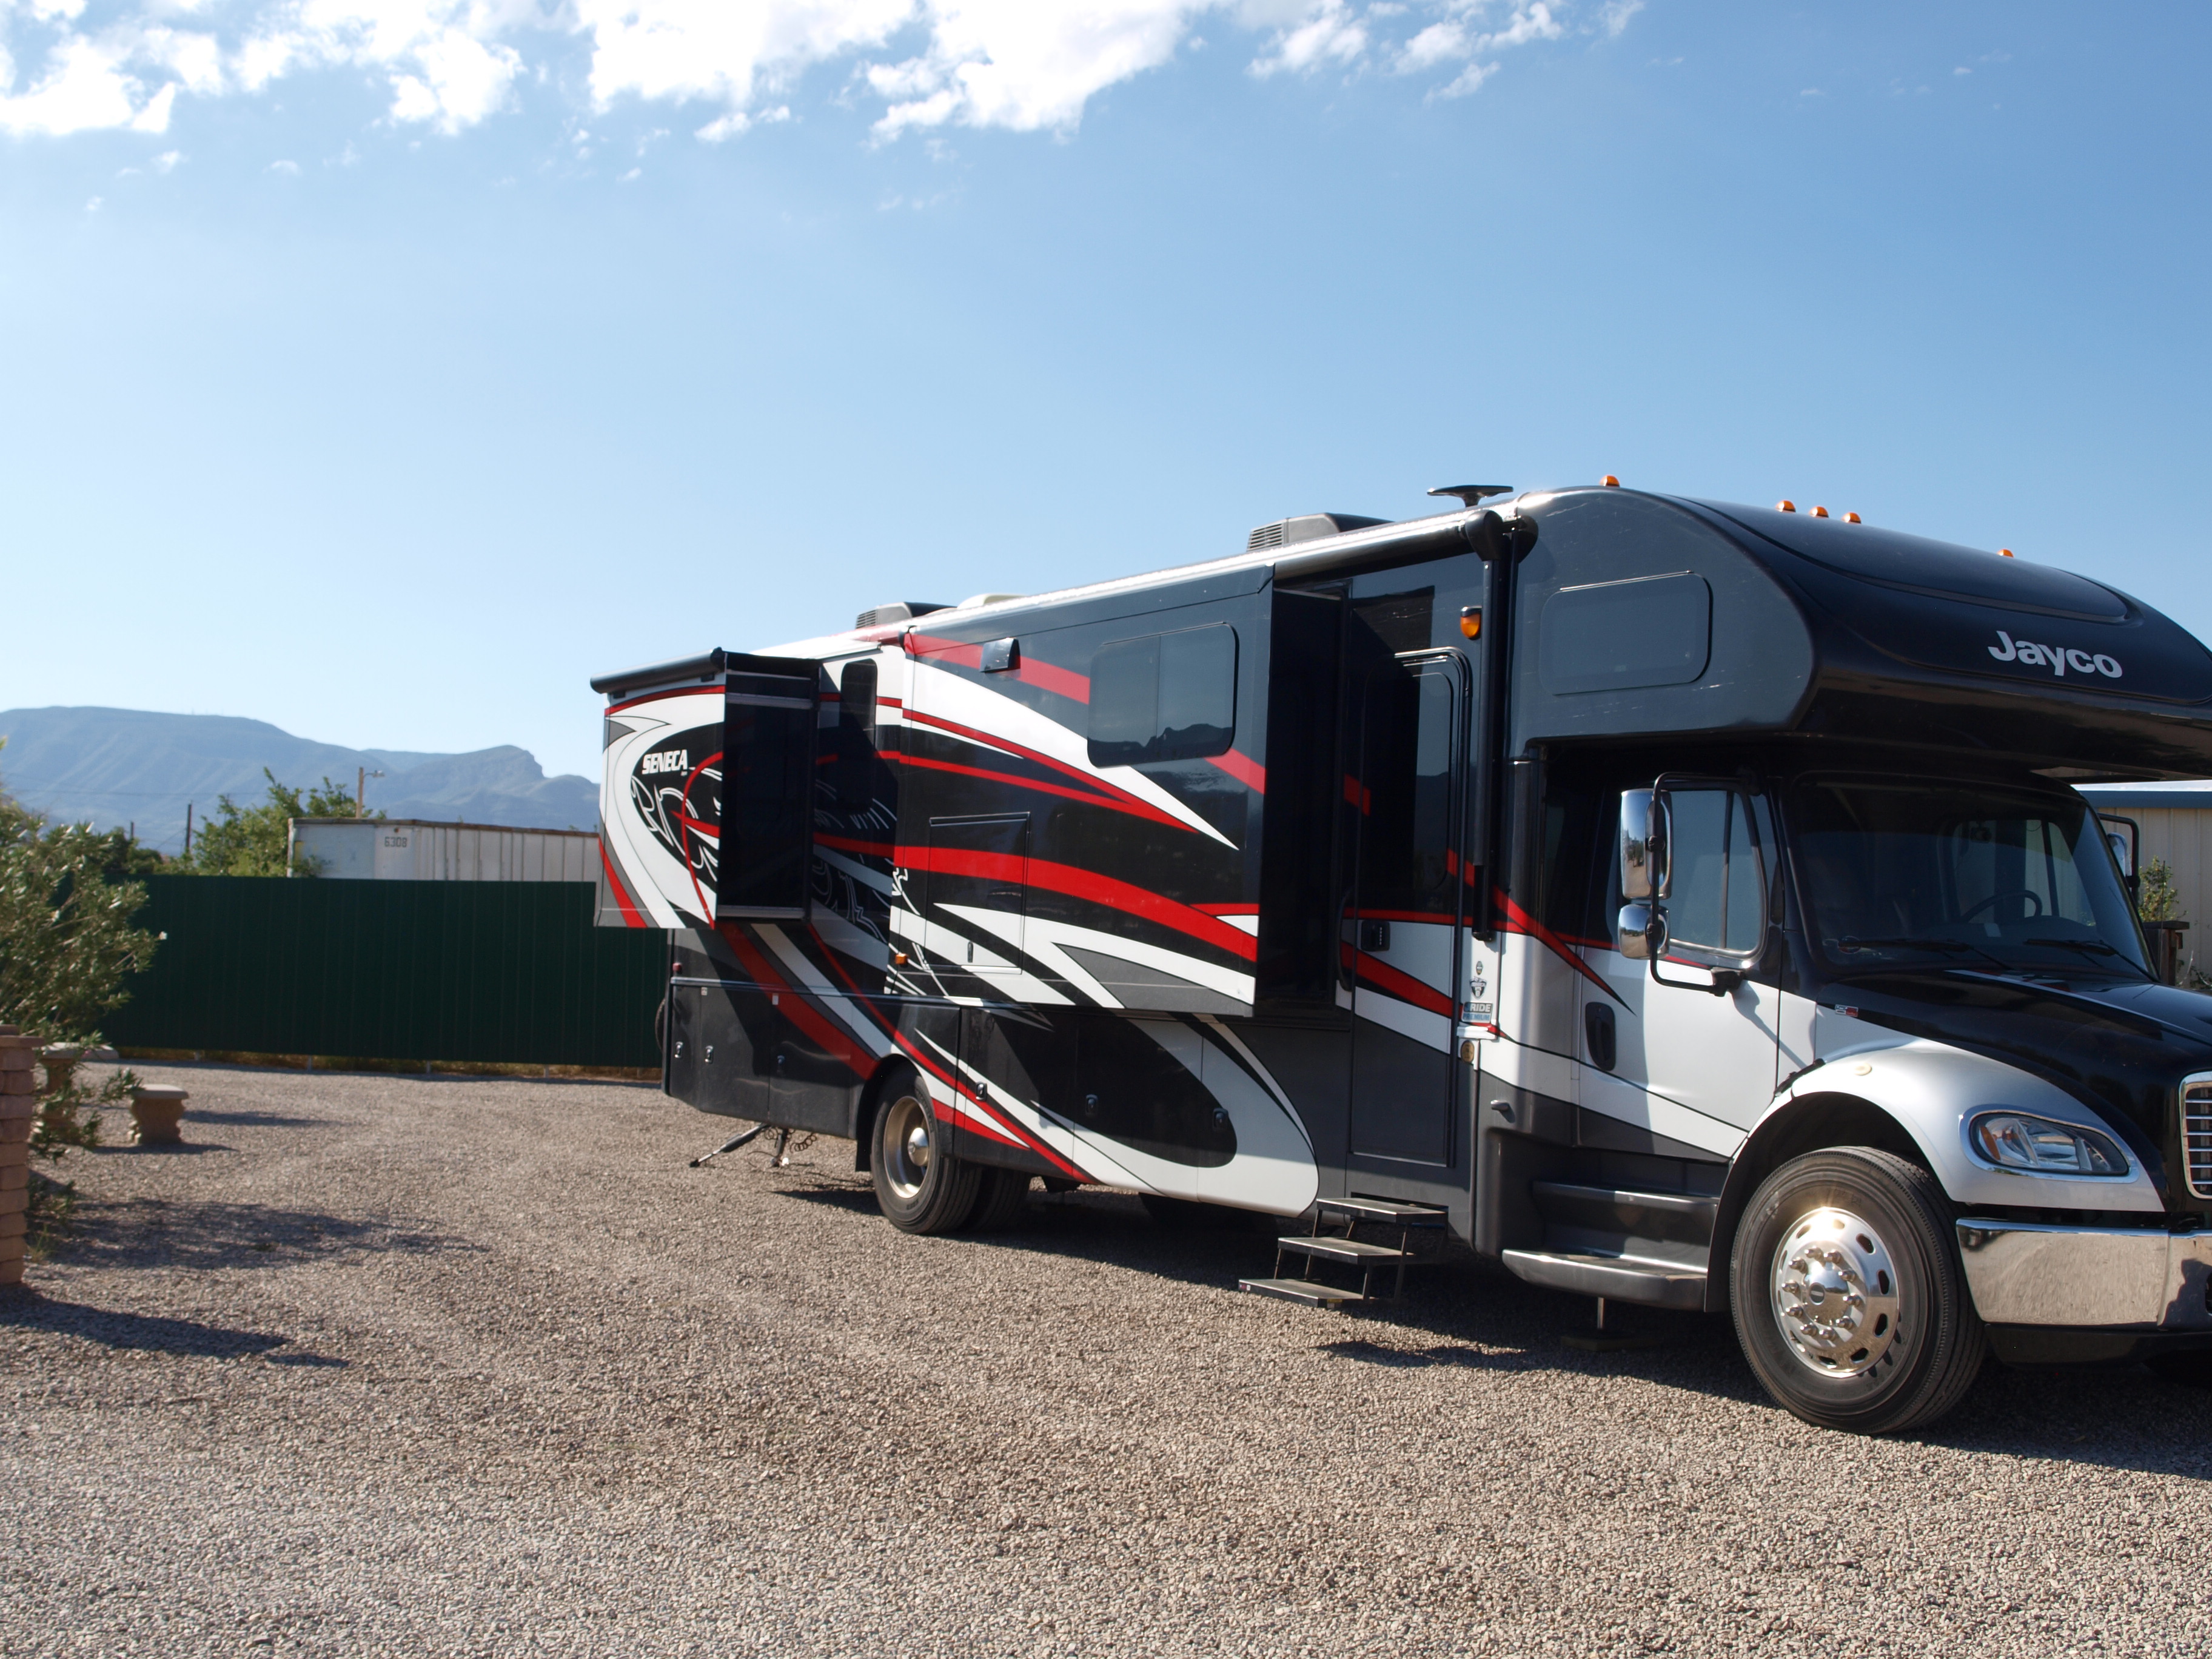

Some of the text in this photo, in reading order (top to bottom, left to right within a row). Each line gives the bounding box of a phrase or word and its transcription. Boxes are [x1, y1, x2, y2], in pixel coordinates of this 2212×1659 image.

[1988, 631, 2123, 678] Jayco
[642, 749, 688, 775] SENECA
[384, 837, 407, 848] 6308
